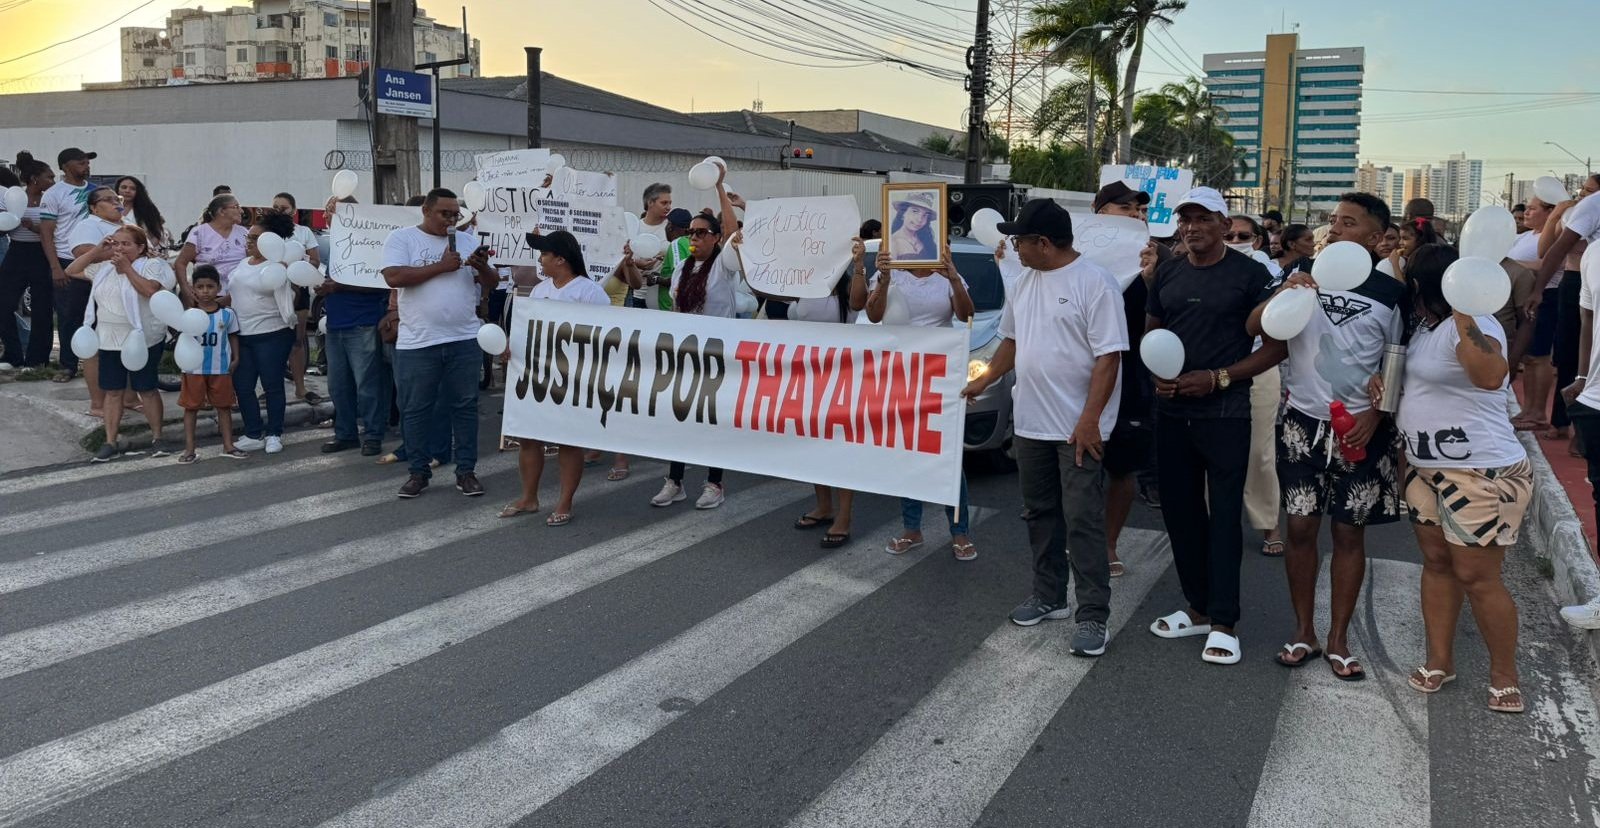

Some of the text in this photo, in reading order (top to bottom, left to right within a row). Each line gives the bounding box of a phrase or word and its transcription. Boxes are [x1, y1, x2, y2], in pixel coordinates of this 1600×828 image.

[385, 74, 405, 85] Ana
[385, 88, 421, 100] Jansen
[1156, 167, 1179, 180] FIM
[504, 216, 522, 229] POR
[201, 332, 218, 347] 10
[515, 319, 947, 455] JUSTIÇA POR THAYANNE
